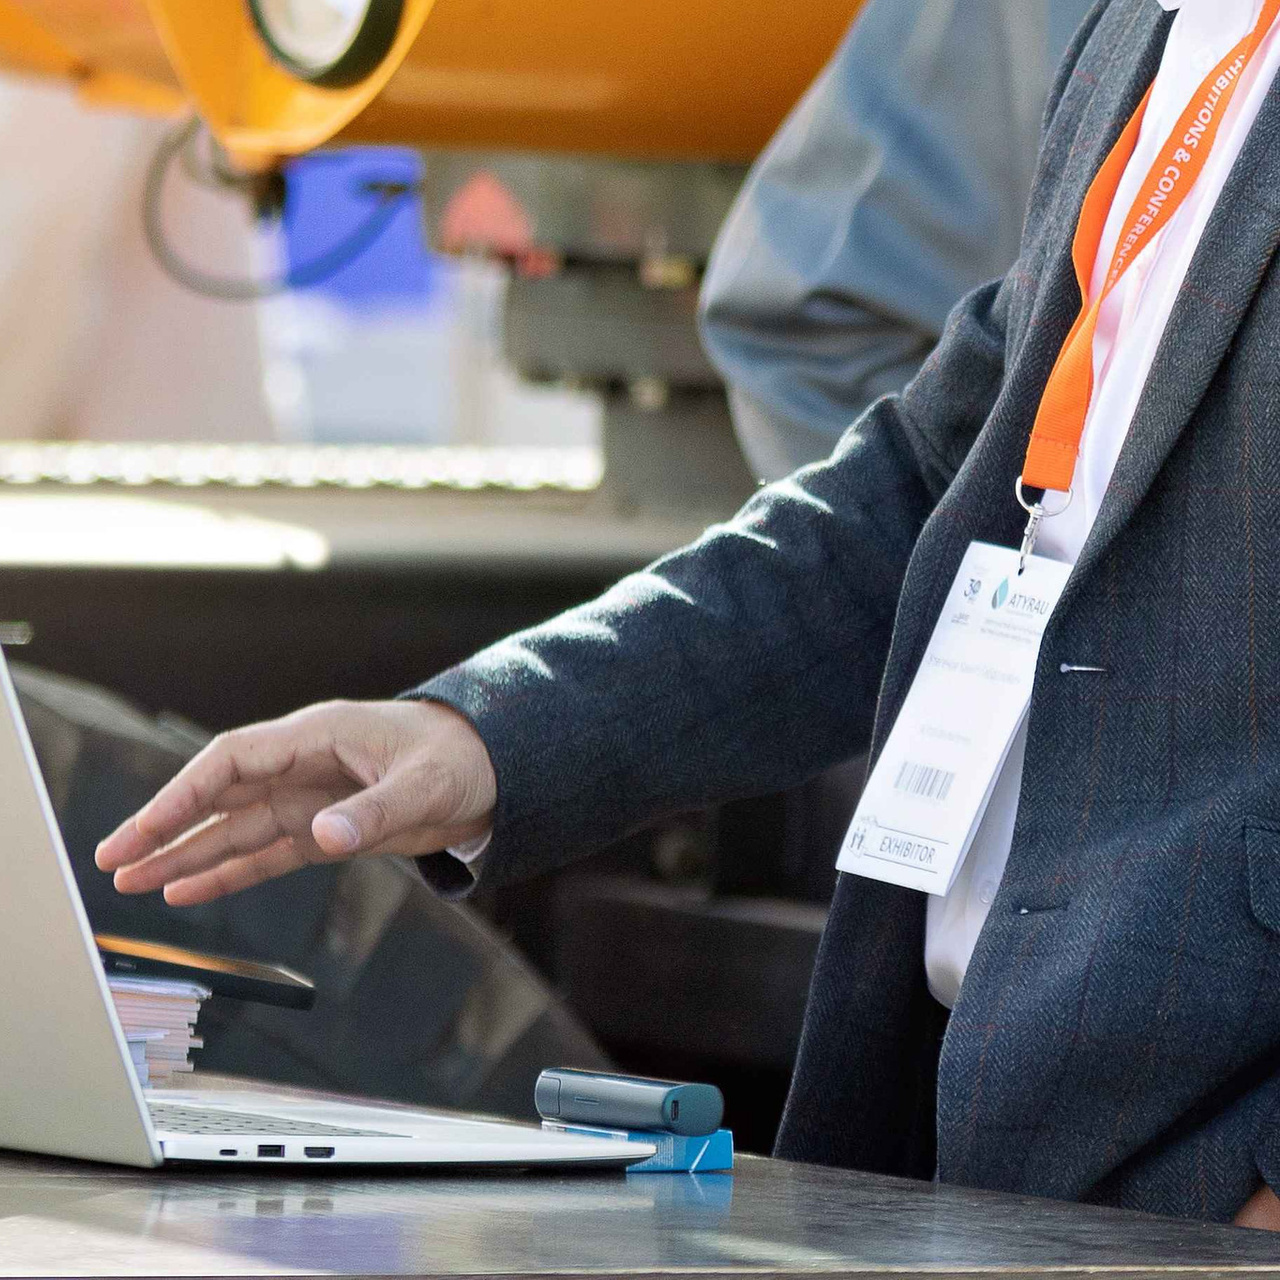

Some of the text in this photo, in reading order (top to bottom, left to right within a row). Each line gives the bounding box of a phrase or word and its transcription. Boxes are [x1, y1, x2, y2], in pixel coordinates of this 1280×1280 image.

[1184, 54, 1246, 149] HIBITIONS
[1173, 148, 1191, 164] &
[1008, 593, 1050, 615] ATYRAU
[879, 836, 936, 864] EXHIBITOR
